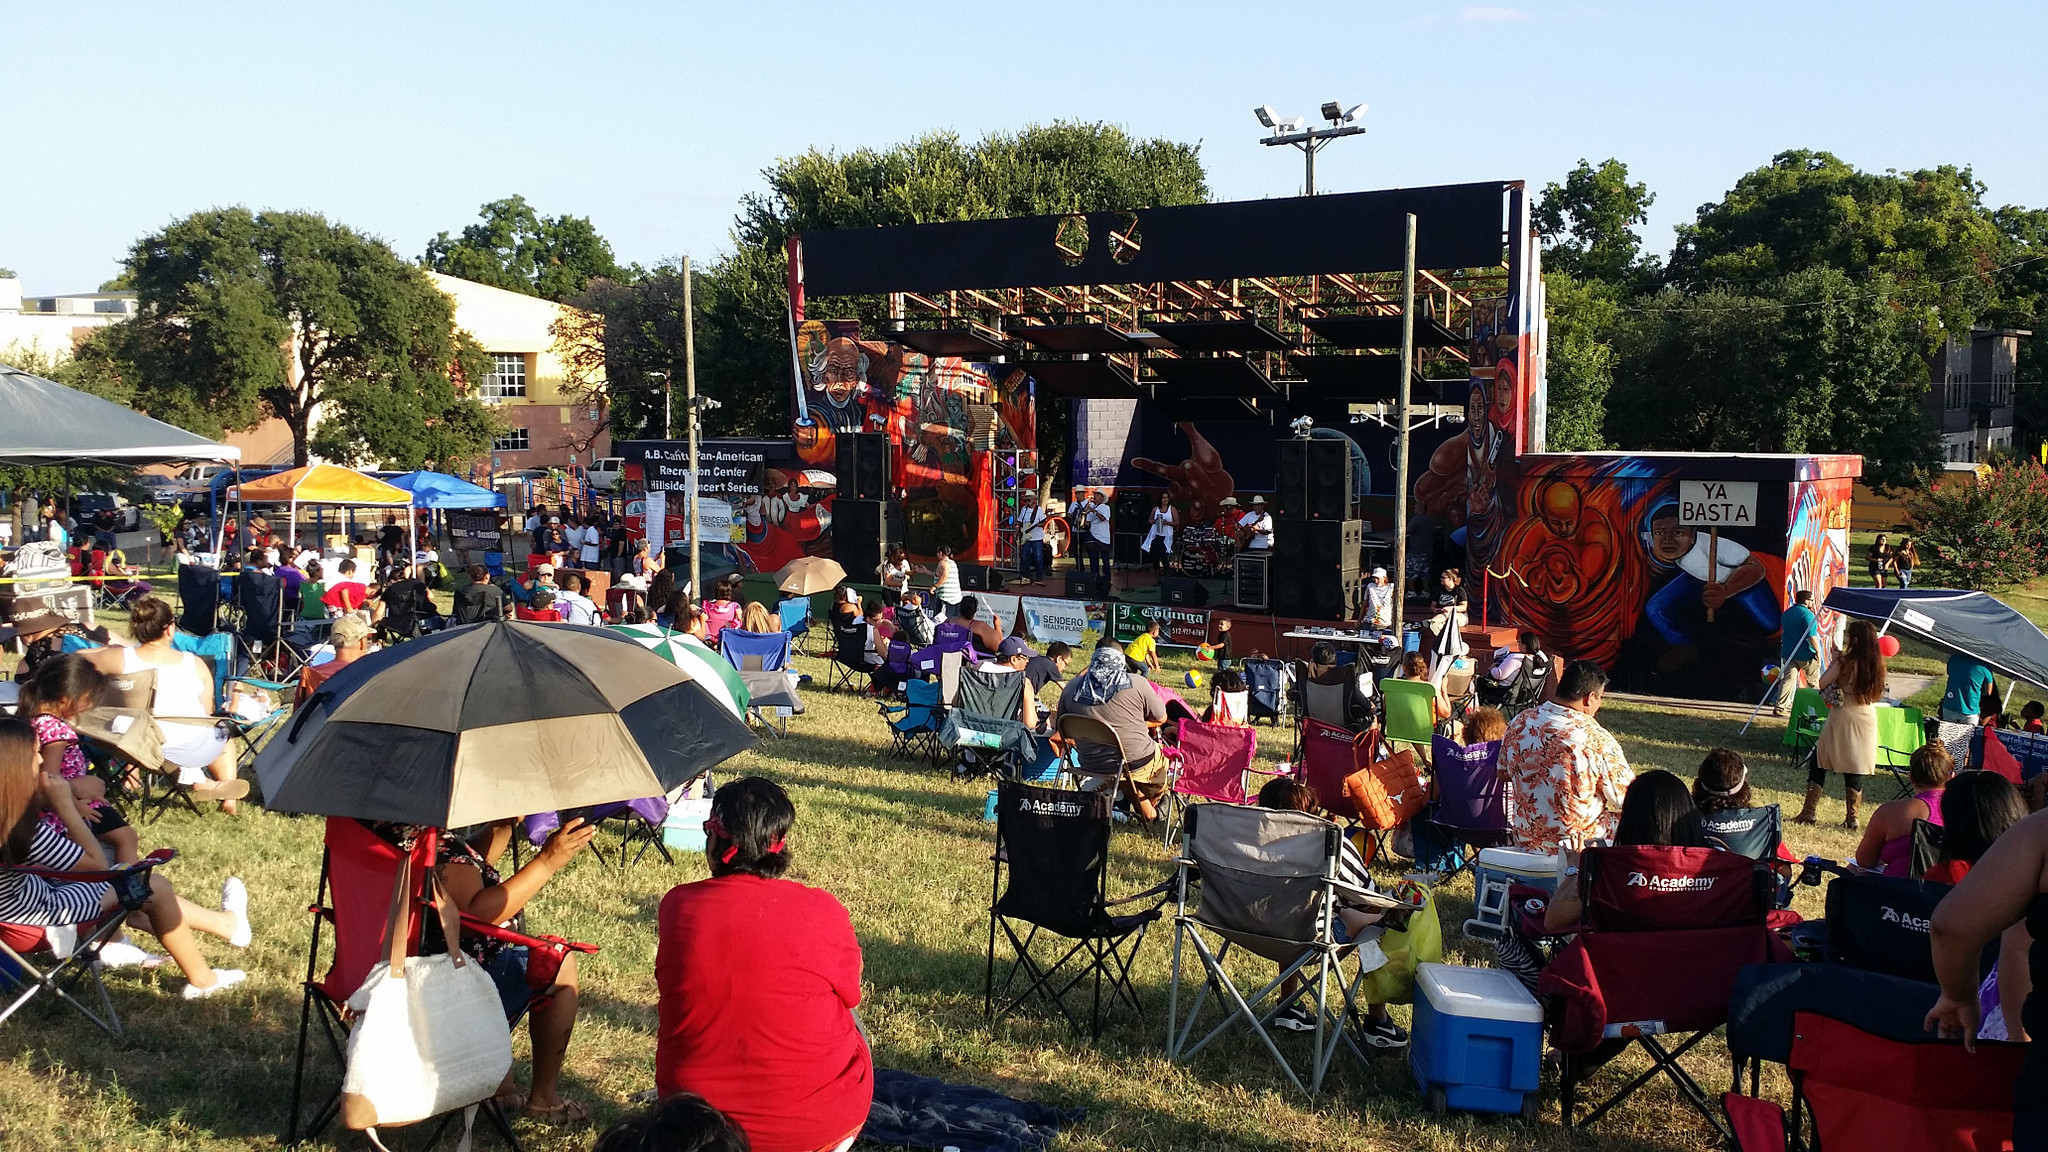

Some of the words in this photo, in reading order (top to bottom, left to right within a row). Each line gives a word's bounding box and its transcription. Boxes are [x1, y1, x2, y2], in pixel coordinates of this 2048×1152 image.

[645, 449, 664, 460] A.B.
[713, 466, 747, 477] Center
[650, 480, 686, 491] Hillside
[727, 481, 759, 493] Series
[1702, 482, 1727, 500] YA
[1682, 501, 1750, 522] BASTA
[1043, 614, 1084, 627] SENDERO
[1141, 606, 1204, 624] Colunga
[1043, 623, 1065, 631] HEALTH
[1033, 799, 1082, 817] Academy
[1707, 818, 1754, 831] Academy
[1649, 875, 1715, 890] Academy
